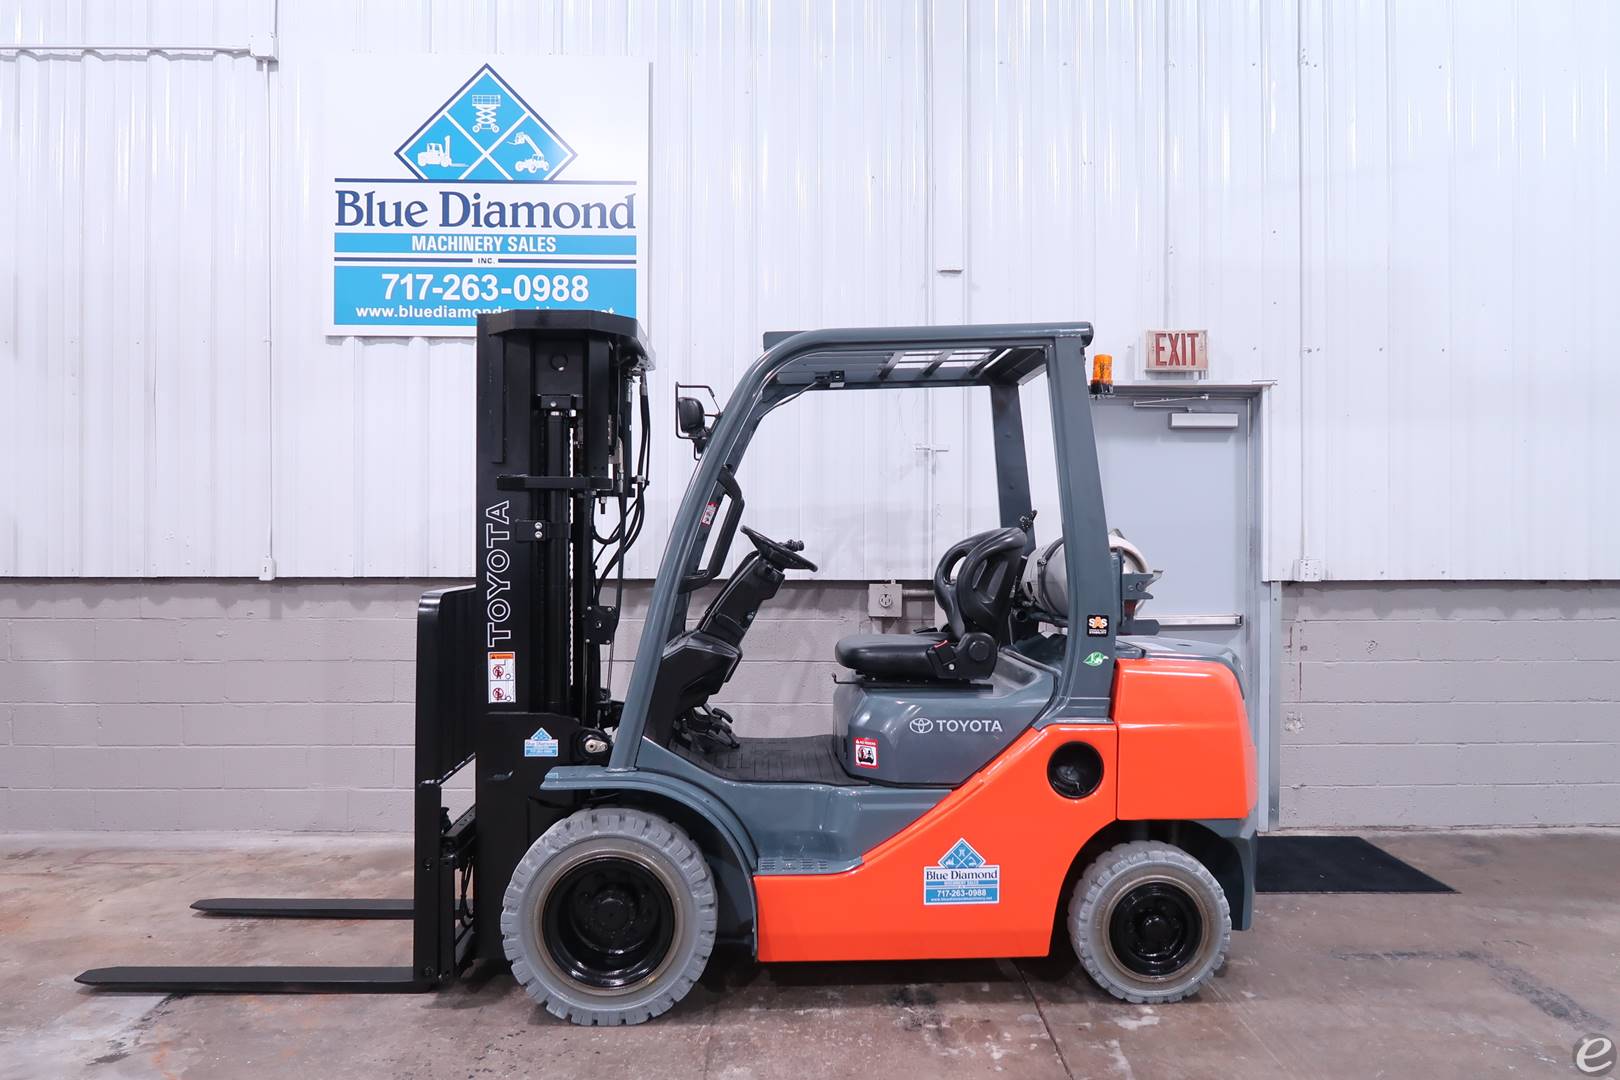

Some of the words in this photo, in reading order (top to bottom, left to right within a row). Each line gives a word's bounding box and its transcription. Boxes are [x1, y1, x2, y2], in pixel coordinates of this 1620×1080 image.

[335, 190, 428, 227] Blue
[439, 191, 636, 229] Diamond
[411, 235, 503, 252] MACHINERY
[507, 236, 557, 252] SALES
[477, 257, 496, 265] INC.
[382, 273, 590, 302] 717-263-0988
[1155, 333, 1199, 366] EXIT
[486, 500, 511, 647] TOYOTA
[936, 720, 1003, 732] TOYOTA
[926, 871, 948, 880] Blue
[951, 870, 997, 879] Diamond
